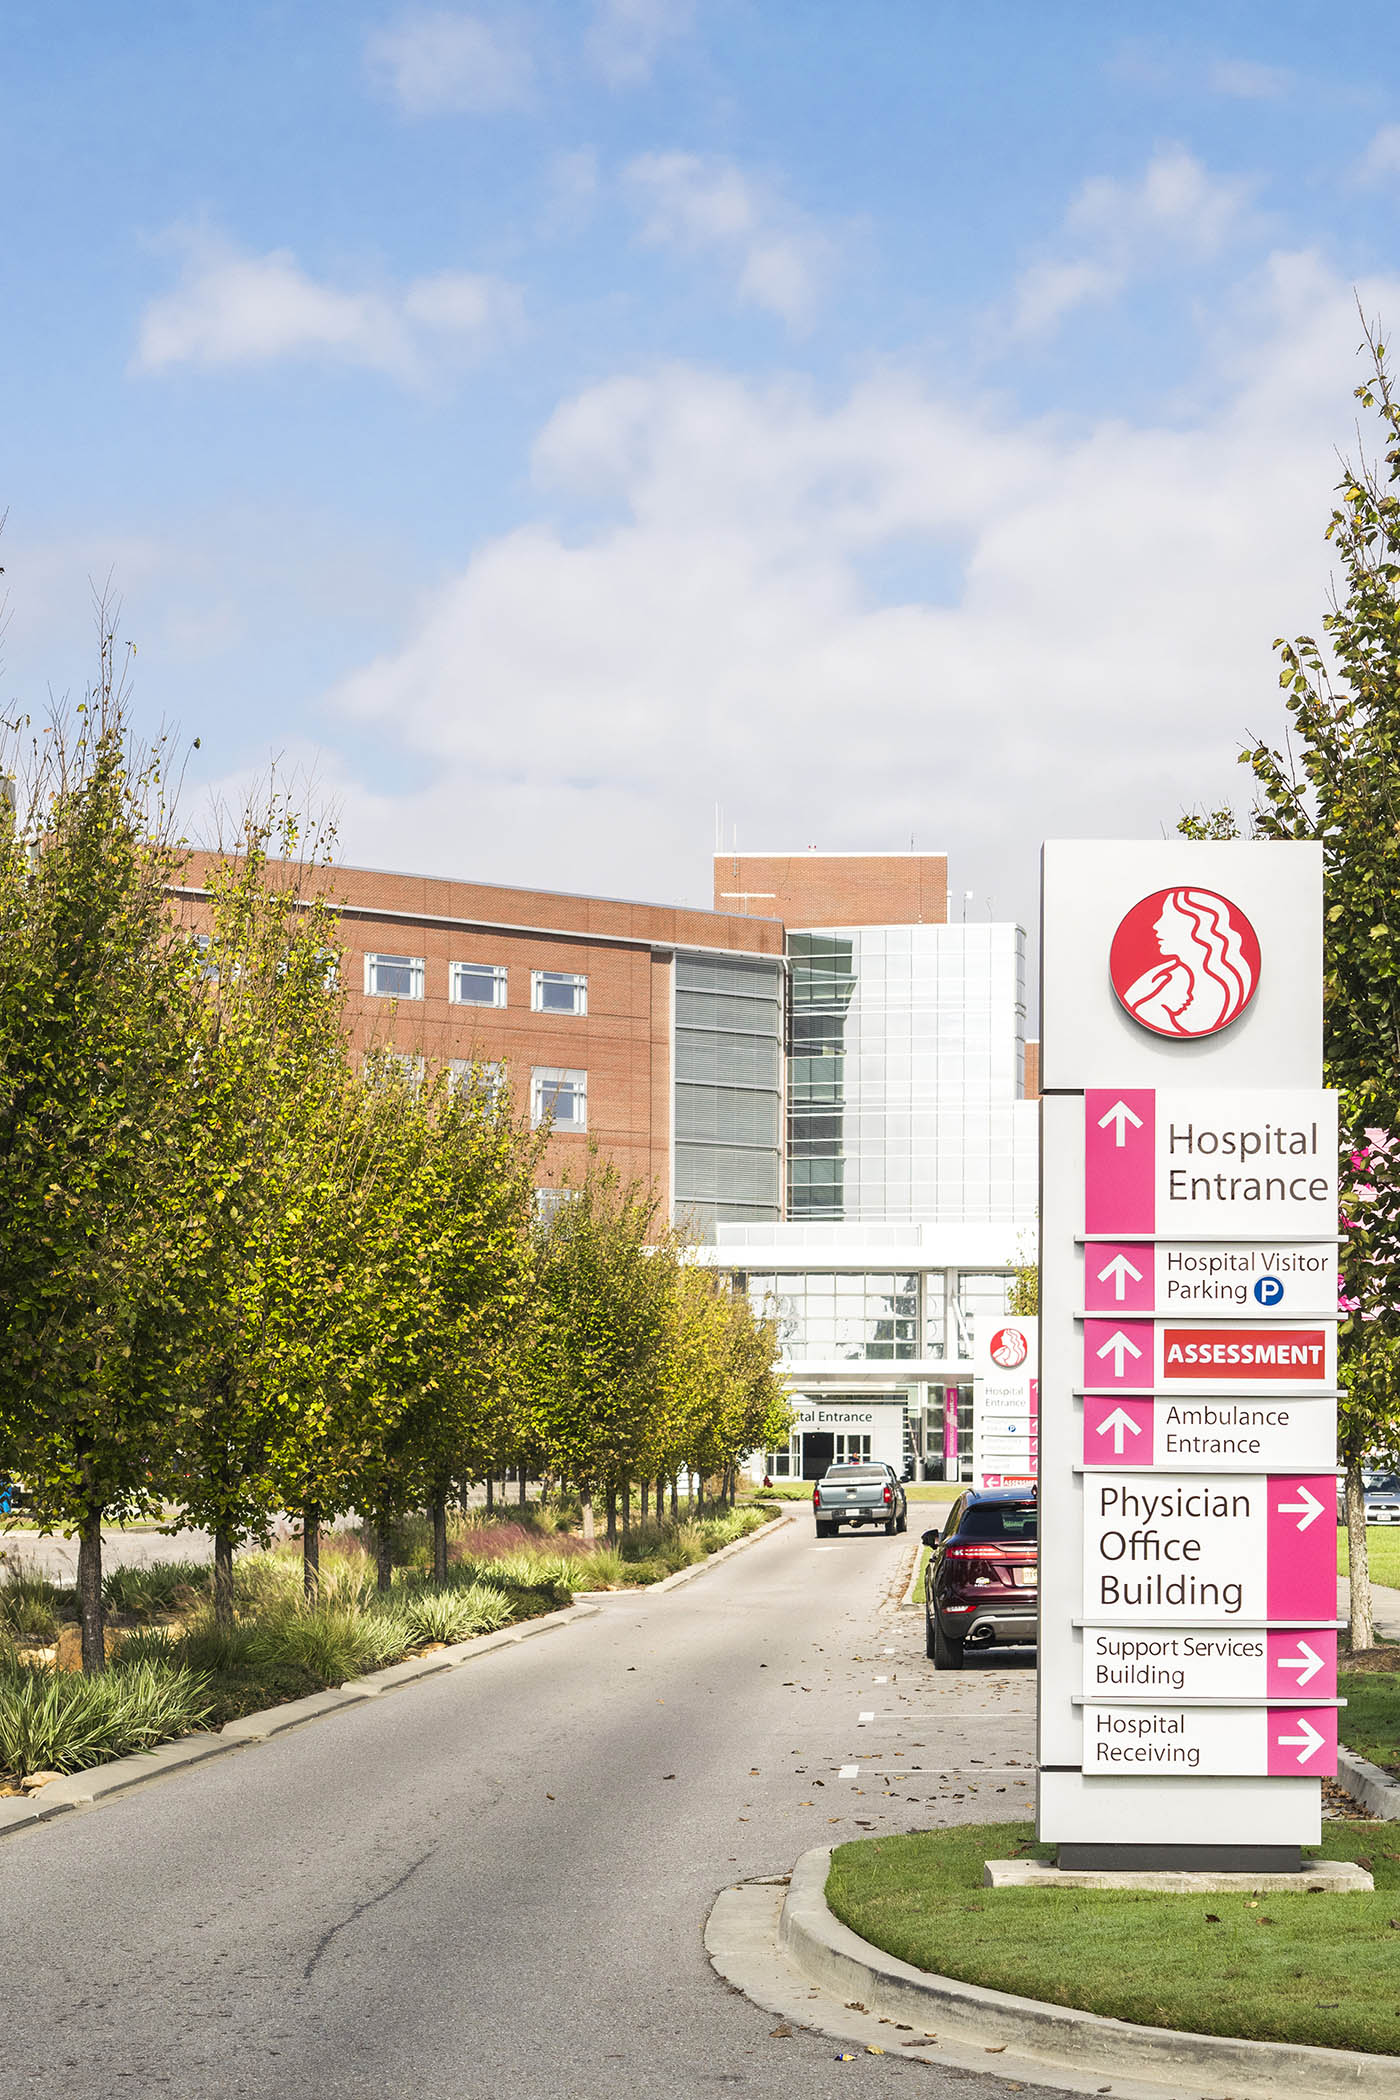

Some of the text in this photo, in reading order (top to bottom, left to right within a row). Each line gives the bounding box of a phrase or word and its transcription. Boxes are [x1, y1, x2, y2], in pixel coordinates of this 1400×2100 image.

[1170, 1123, 1316, 1163] Hospital
[1170, 1170, 1328, 1201] Entrance
[1168, 1252, 1328, 1276] Hospital Visitor
[1168, 1280, 1279, 1304] Parking P
[1168, 1344, 1323, 1364] ASSESSMENT
[985, 1386, 1024, 1398] Hospital
[985, 1398, 1026, 1407] Entrance
[819, 1411, 872, 1422] Entrance
[1167, 1406, 1289, 1425] Ambulance
[1167, 1434, 1260, 1453] Entrance
[1101, 1486, 1249, 1525] Physician
[1100, 1530, 1200, 1561] Office
[1101, 1574, 1242, 1613] Building
[1096, 1637, 1263, 1661] Support Services
[1097, 1665, 1184, 1689] Building
[1097, 1714, 1184, 1738] Hospital
[1097, 1743, 1199, 1767] Receiving
